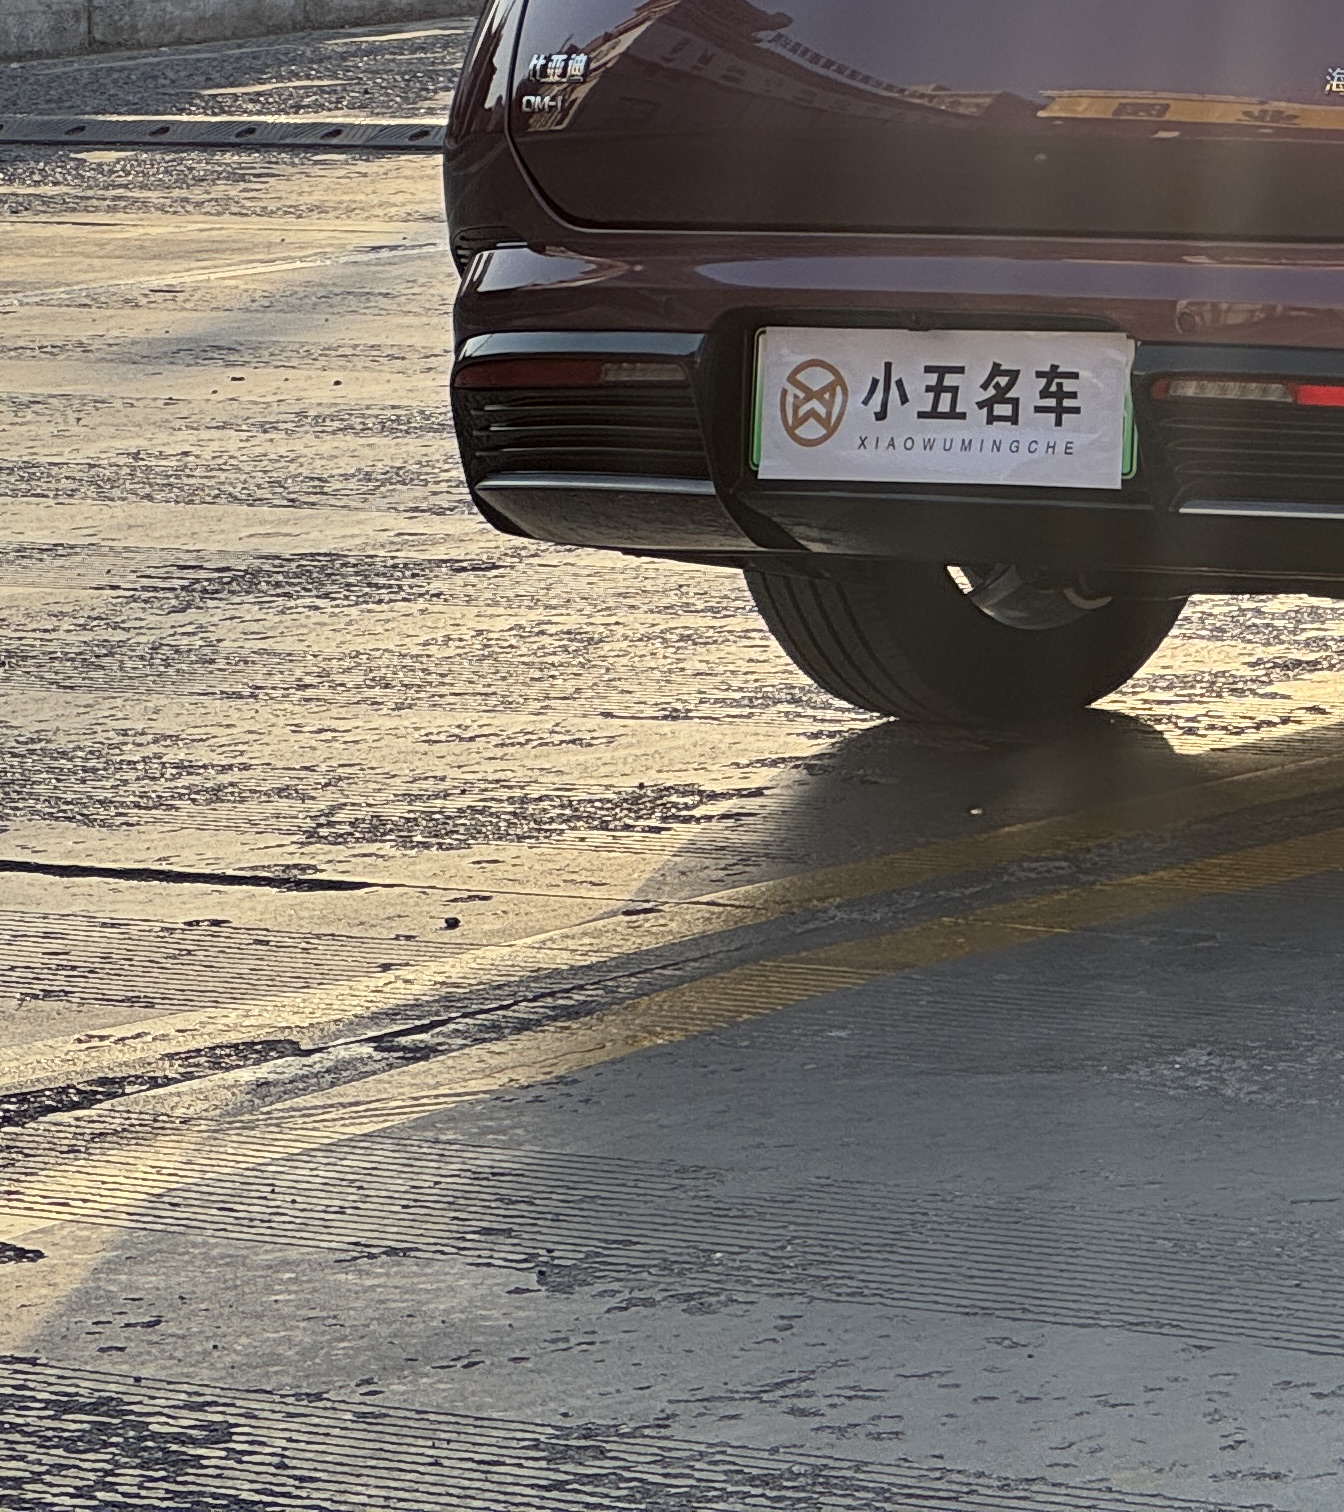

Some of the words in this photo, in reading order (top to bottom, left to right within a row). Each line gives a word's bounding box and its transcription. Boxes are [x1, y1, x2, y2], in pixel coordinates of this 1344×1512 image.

[860, 360, 1083, 428] 小五名车
[856, 434, 1077, 457] XIAOWUMINGCHE
